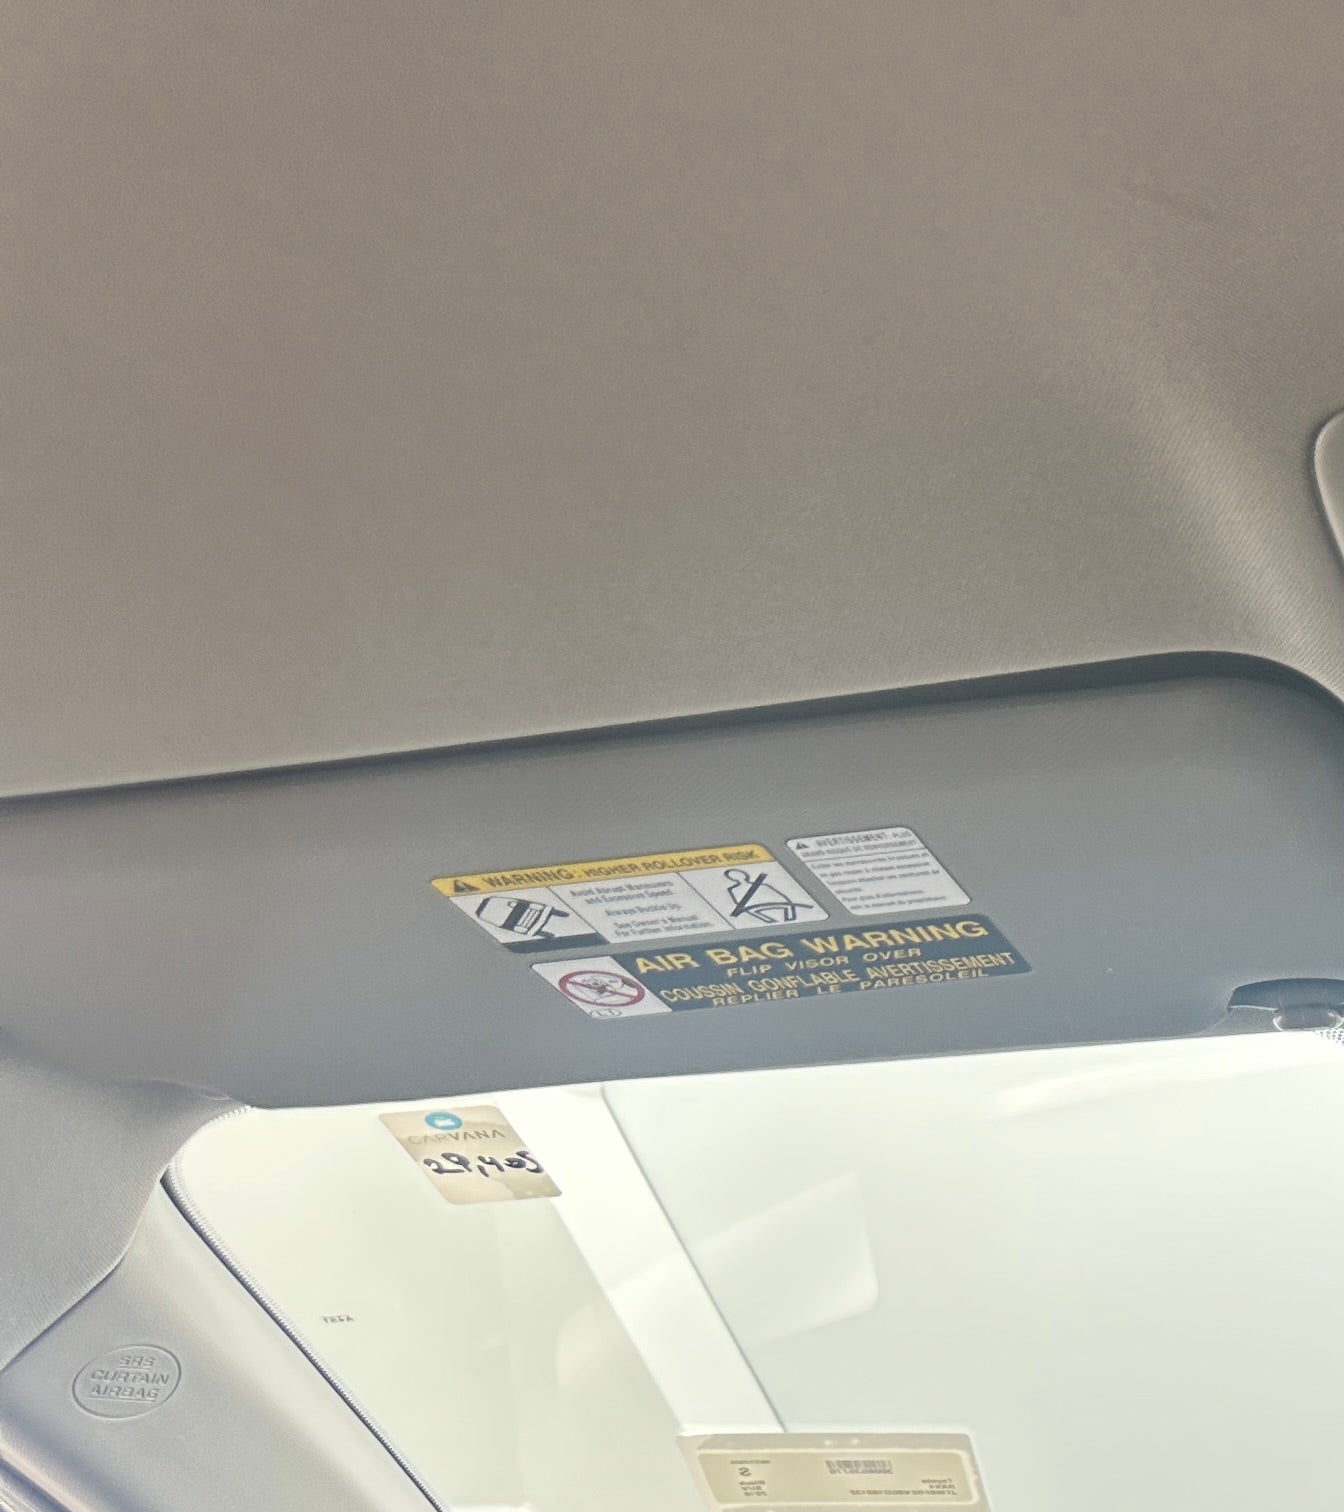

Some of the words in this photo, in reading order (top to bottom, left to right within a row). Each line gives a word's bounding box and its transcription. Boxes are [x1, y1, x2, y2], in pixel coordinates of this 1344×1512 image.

[583, 863, 641, 877] HIGHER
[641, 854, 722, 871] ROLLOVER
[721, 849, 761, 862] RISK
[635, 953, 701, 975] AIR
[705, 941, 795, 966] BAG
[800, 920, 990, 954] WARNING
[726, 964, 773, 979] FLIP
[784, 955, 849, 971] VISOR
[862, 948, 922, 963] OVER
[659, 982, 745, 1004] COUSSIN
[748, 968, 861, 993] GONFLABLE
[865, 952, 1016, 980] AVERTISSEMENT
[712, 989, 799, 1007] REPLIER
[816, 983, 842, 995] LE
[859, 969, 989, 990] PARESOLEIL
[407, 1129, 507, 1145] CARVANA
[118, 1355, 156, 1367] SRS
[88, 1383, 161, 1399] AIRBAG
[90, 1369, 170, 1385] CURTAIN
